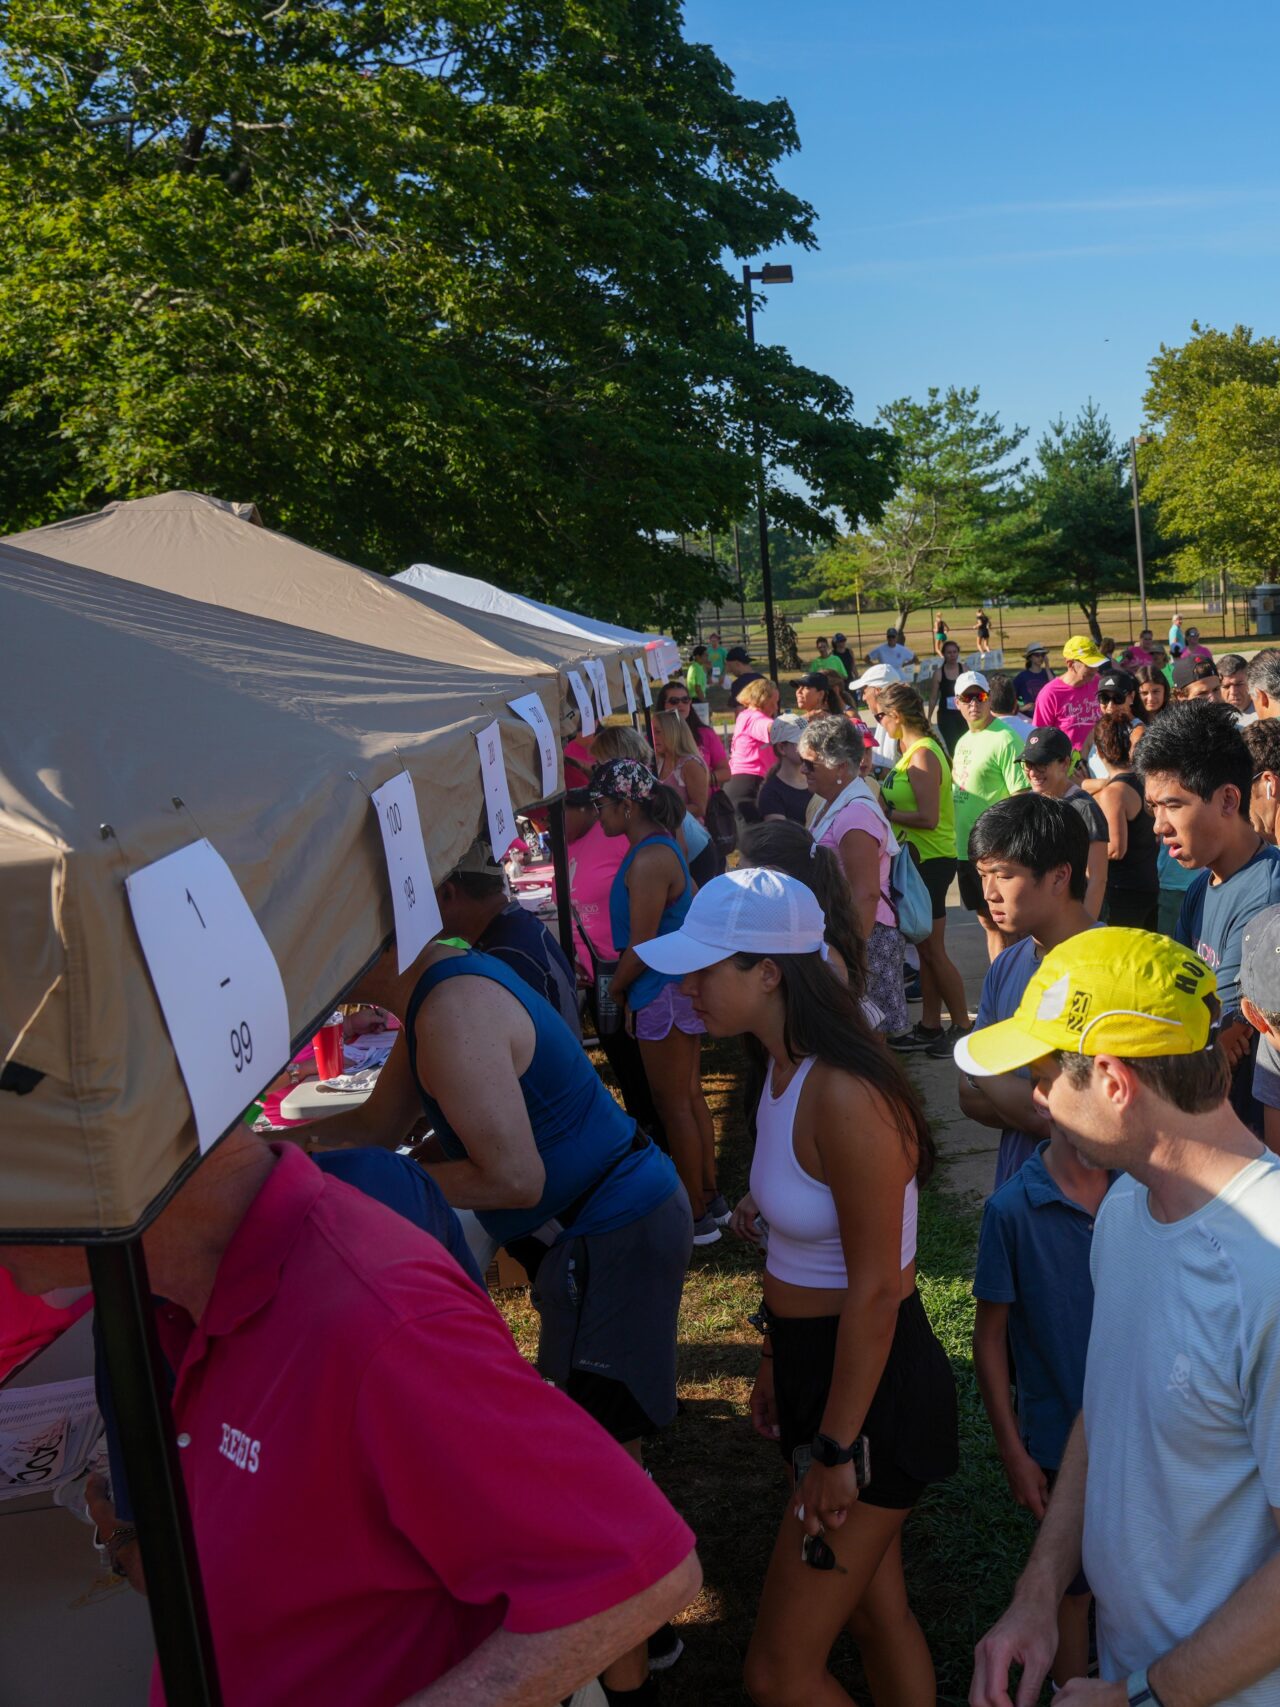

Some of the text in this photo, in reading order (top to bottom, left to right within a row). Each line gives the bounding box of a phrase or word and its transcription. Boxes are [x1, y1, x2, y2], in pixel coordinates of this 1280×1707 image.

[386, 802, 402, 837] 100
[185, 887, 206, 929] 1
[1174, 956, 1212, 995] HO
[230, 1021, 253, 1074] 99
[218, 1422, 262, 1474] REGIS
